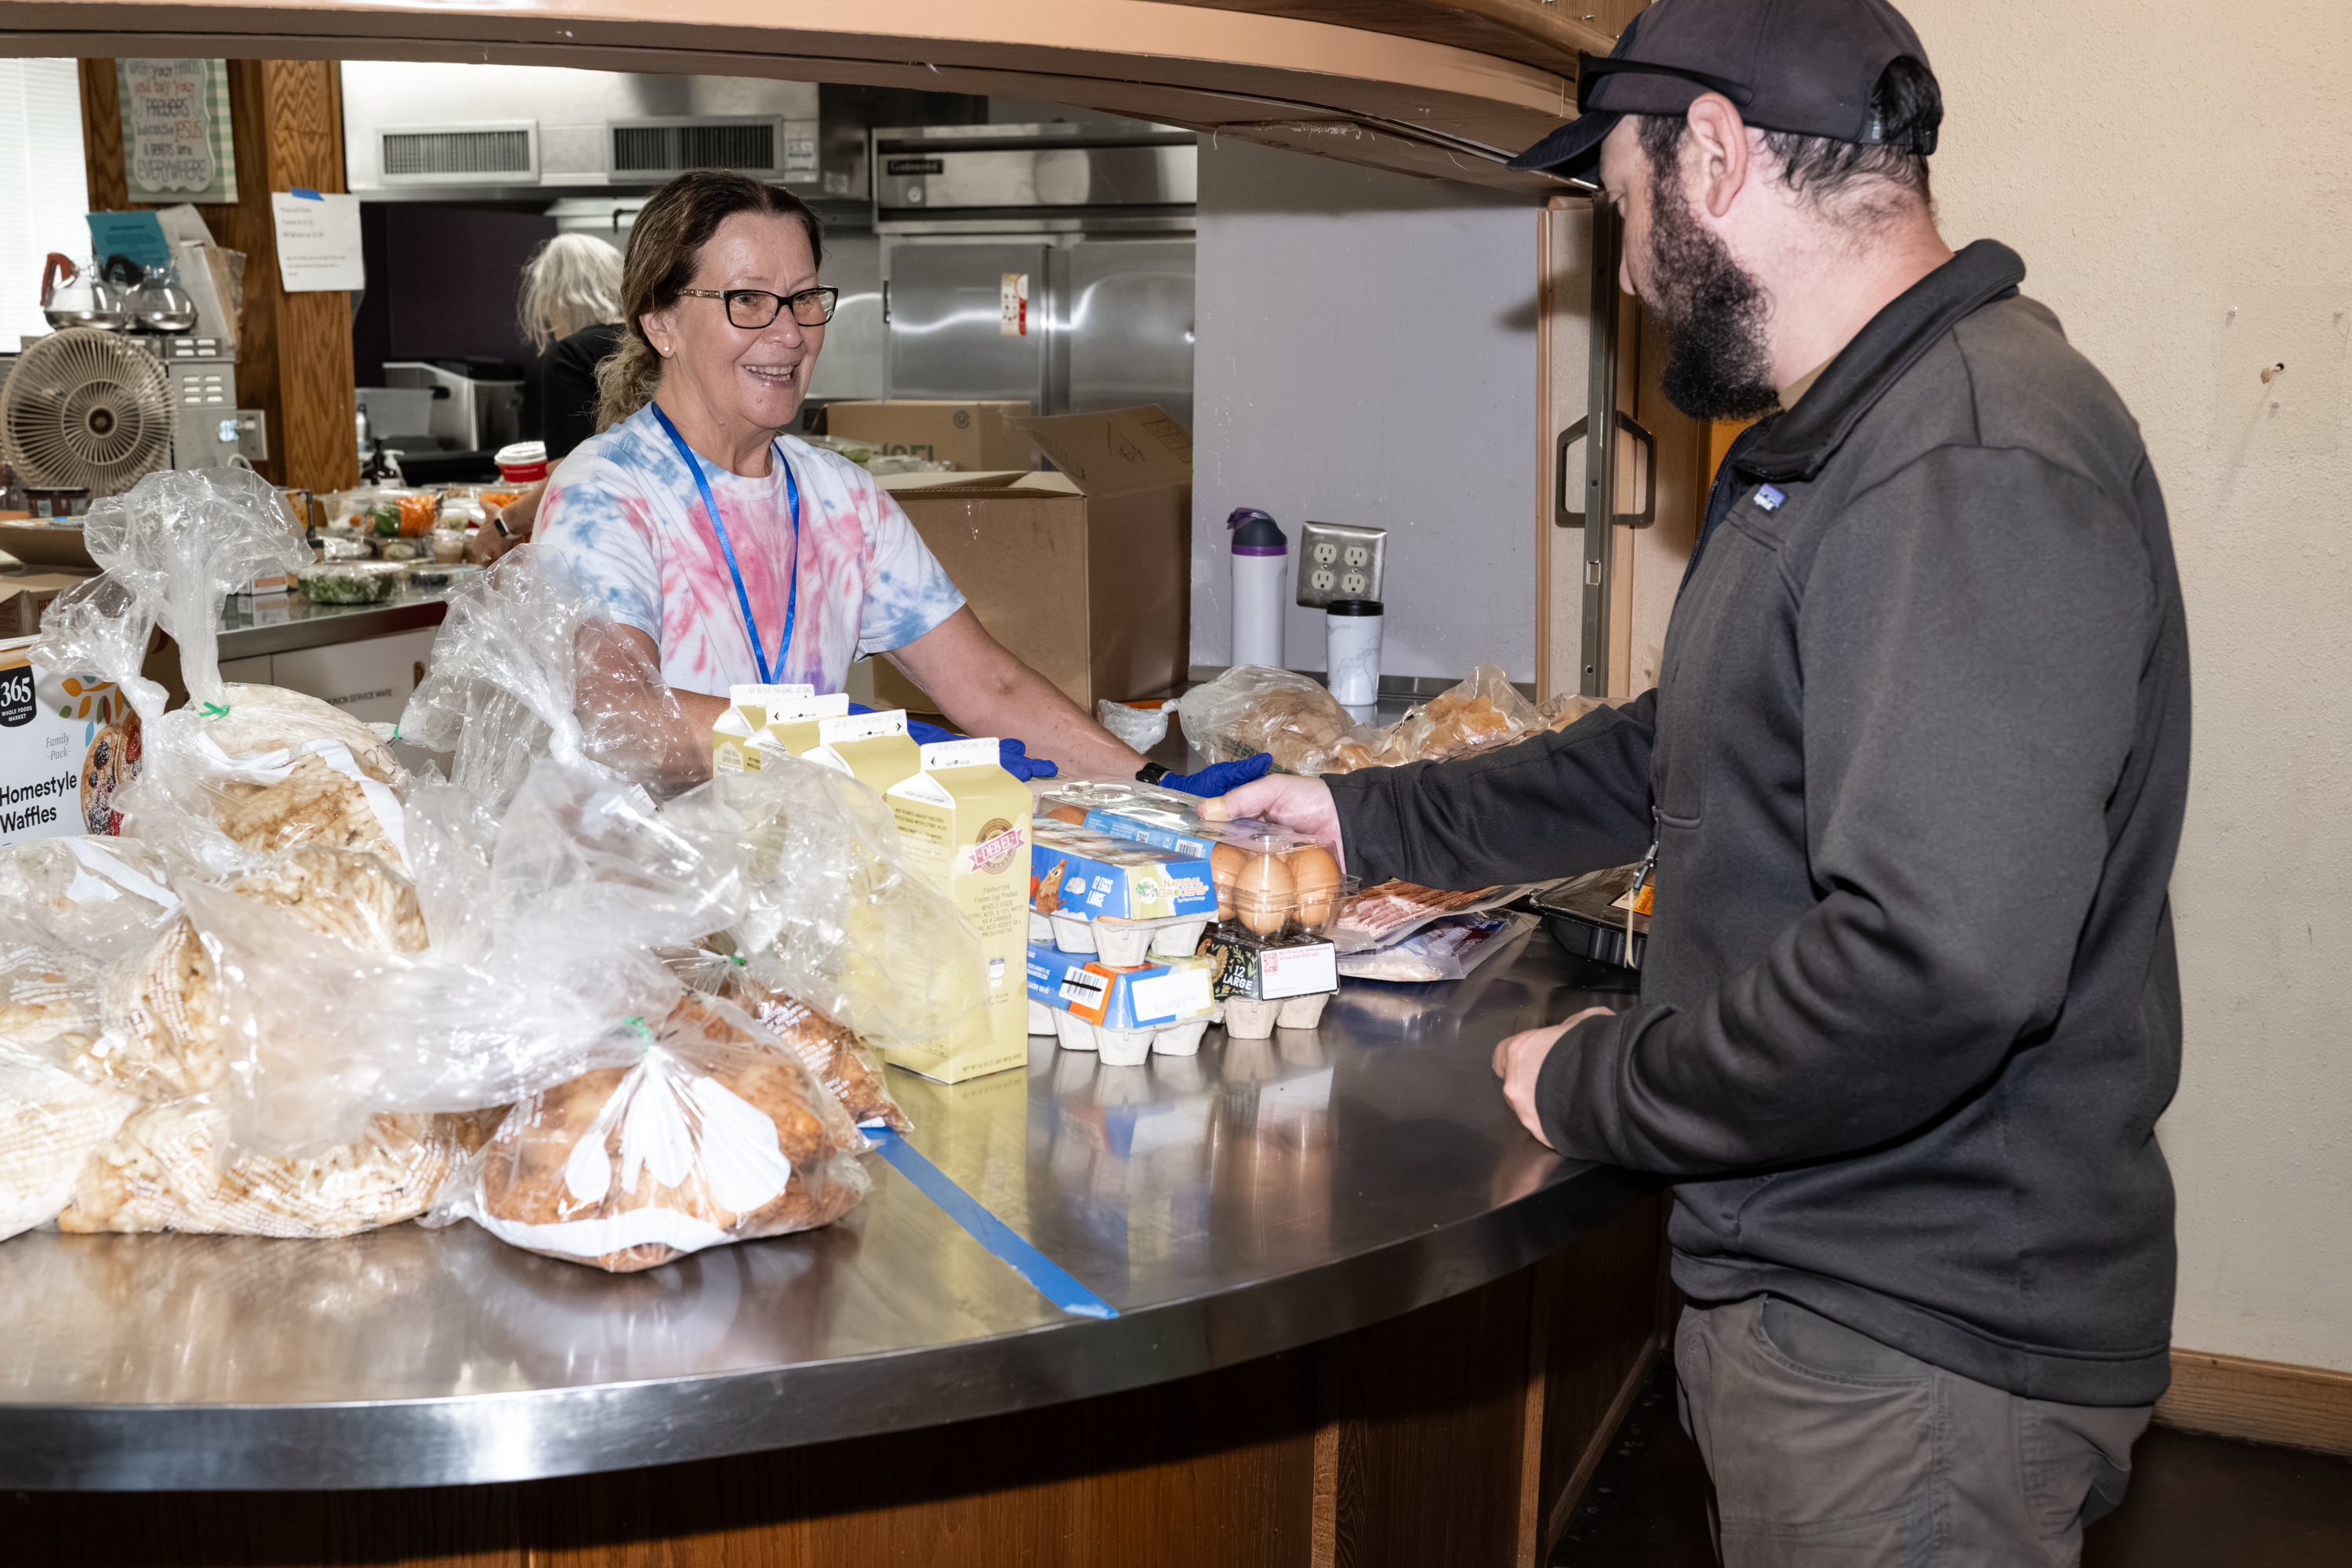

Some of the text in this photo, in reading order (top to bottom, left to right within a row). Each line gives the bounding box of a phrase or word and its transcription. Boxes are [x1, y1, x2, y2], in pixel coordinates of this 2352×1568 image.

[1, 676, 31, 707] 365
[45, 732, 71, 748] Family
[0, 771, 77, 807] Homestyle
[0, 804, 56, 834] Waffles
[981, 836, 1011, 861] DEB EL
[983, 883, 1011, 894] Pasteurized
[1091, 876, 1113, 894] 12 EGGS
[1163, 877, 1203, 887] NATURAL
[1002, 891, 1018, 899] Product
[1087, 890, 1105, 908] LARGE
[1157, 886, 1206, 898] GROCERS
[982, 902, 999, 911] WHOLE
[982, 927, 1013, 937] PRESERVATIVE
[1233, 965, 1246, 978] 12
[1222, 973, 1253, 991] LARGE
